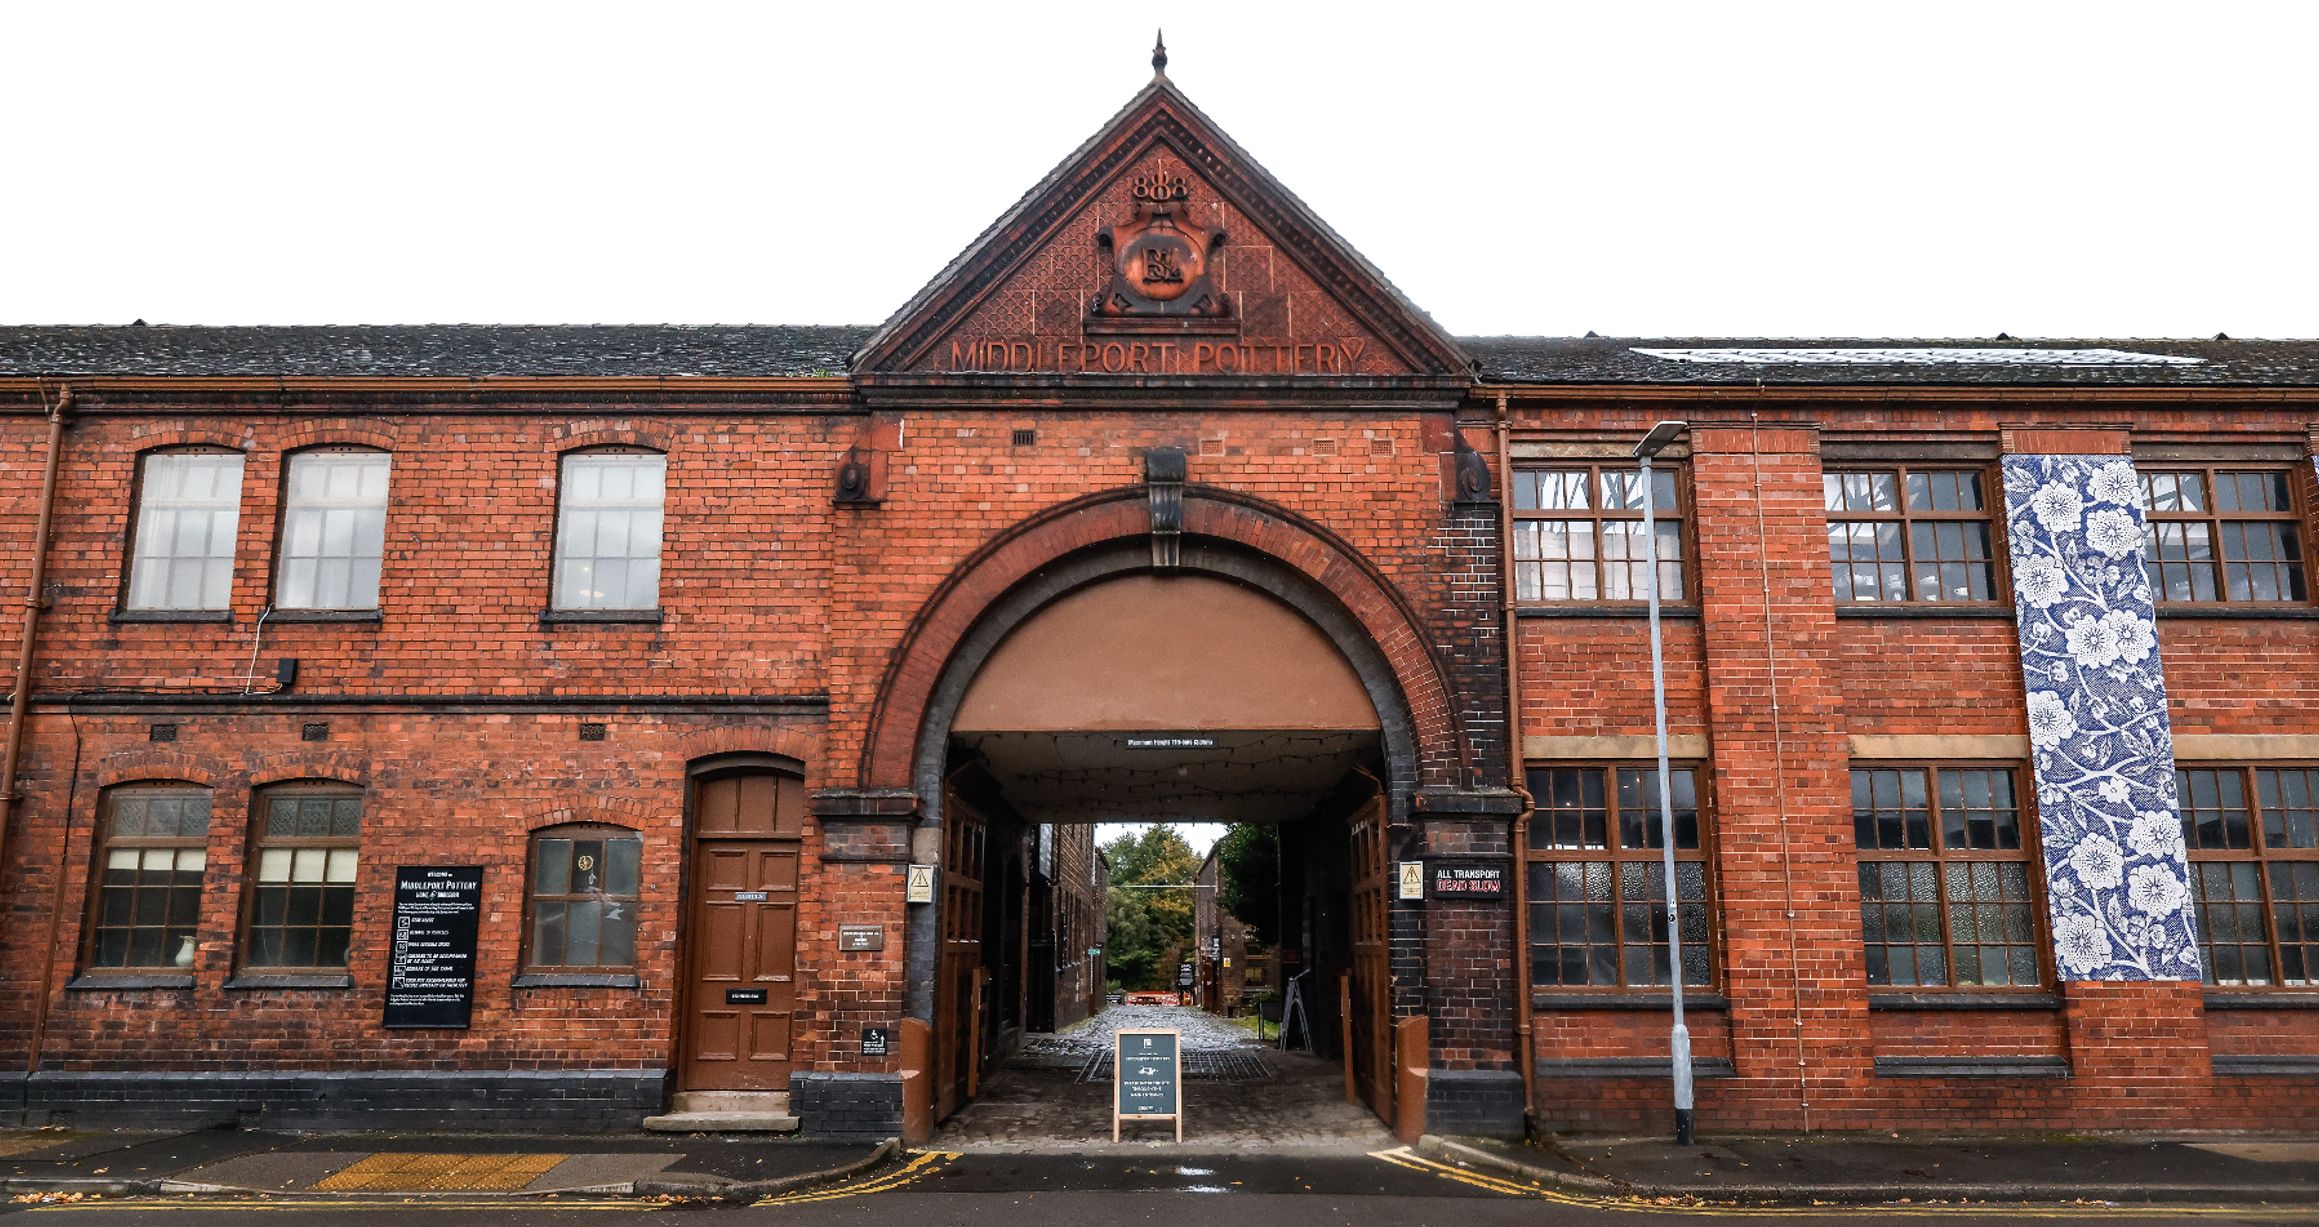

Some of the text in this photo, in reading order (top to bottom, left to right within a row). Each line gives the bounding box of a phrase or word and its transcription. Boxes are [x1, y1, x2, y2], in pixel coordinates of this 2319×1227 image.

[951, 337, 1366, 373] MIDDLEPORT POTTERY
[1437, 869, 1501, 879] ALL TRANSPORT
[1436, 879, 1468, 892] DEAD
[1468, 879, 1501, 893] SLOW
